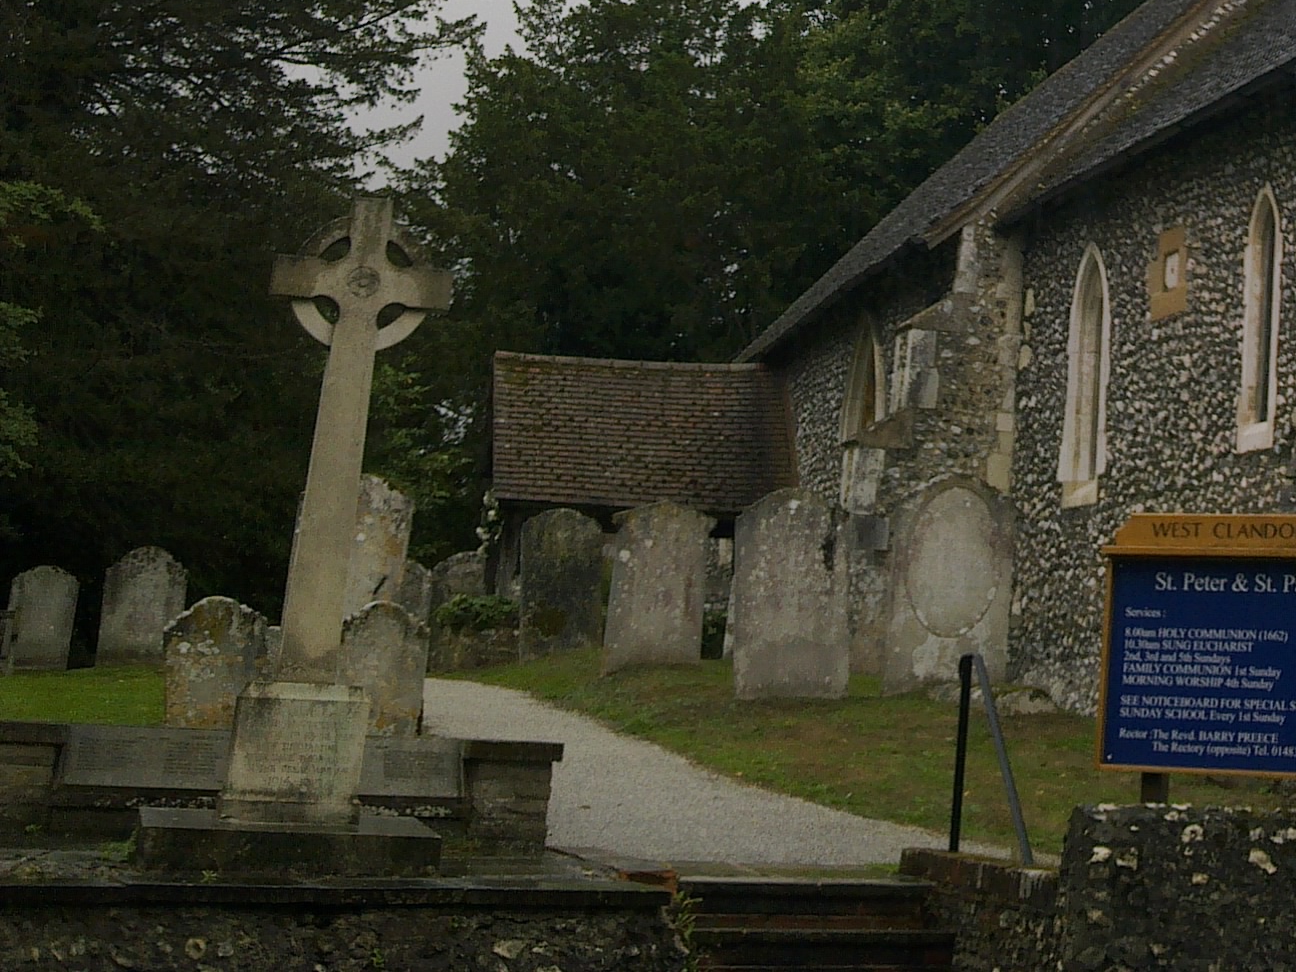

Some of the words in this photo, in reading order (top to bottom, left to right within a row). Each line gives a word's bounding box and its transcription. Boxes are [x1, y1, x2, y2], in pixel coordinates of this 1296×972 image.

[1152, 522, 1202, 539] WEST
[1155, 572, 1177, 591] St.
[1183, 573, 1228, 592] Peter
[1232, 573, 1248, 592] &
[1254, 573, 1277, 593] St.
[1125, 608, 1161, 618] Services
[1158, 629, 1186, 639] HOLY
[1188, 629, 1256, 639] COMMUNION
[1258, 631, 1288, 643] (1662)
[1162, 640, 1191, 650] SUNG
[1193, 641, 1254, 652] EUCHARIST
[1145, 652, 1159, 661] 3rd
[1159, 653, 1177, 662] and
[1178, 653, 1192, 662] 5th
[1194, 653, 1231, 666] Sundays
[1123, 663, 1162, 674] FAMILY
[1164, 664, 1231, 675] COMMUNION
[1235, 666, 1247, 676] 1st
[1248, 666, 1281, 680] Sunday
[1122, 675, 1173, 686] MORNING
[1175, 676, 1223, 687] WORSHIP
[1224, 678, 1239, 688] 4th
[1241, 678, 1274, 692] Sunday
[1120, 695, 1139, 706] SEE
[1142, 696, 1218, 708] NOTICEBOARD
[1220, 699, 1241, 709] FOR
[1244, 699, 1288, 710] SPECIAL
[1120, 708, 1162, 718] SUNDAY
[1165, 709, 1208, 720] SCHOOL
[1210, 711, 1235, 723] Every
[1238, 711, 1251, 721] 1st
[1252, 712, 1285, 725] Sunday
[1171, 730, 1196, 741] Revd.
[1199, 731, 1234, 741] BARRY
[1237, 733, 1278, 743] PREECE
[1153, 742, 1169, 752] The
[1171, 742, 1205, 756] Rectory
[1207, 744, 1251, 756] (opposite)
[1254, 745, 1269, 756] Tel.
